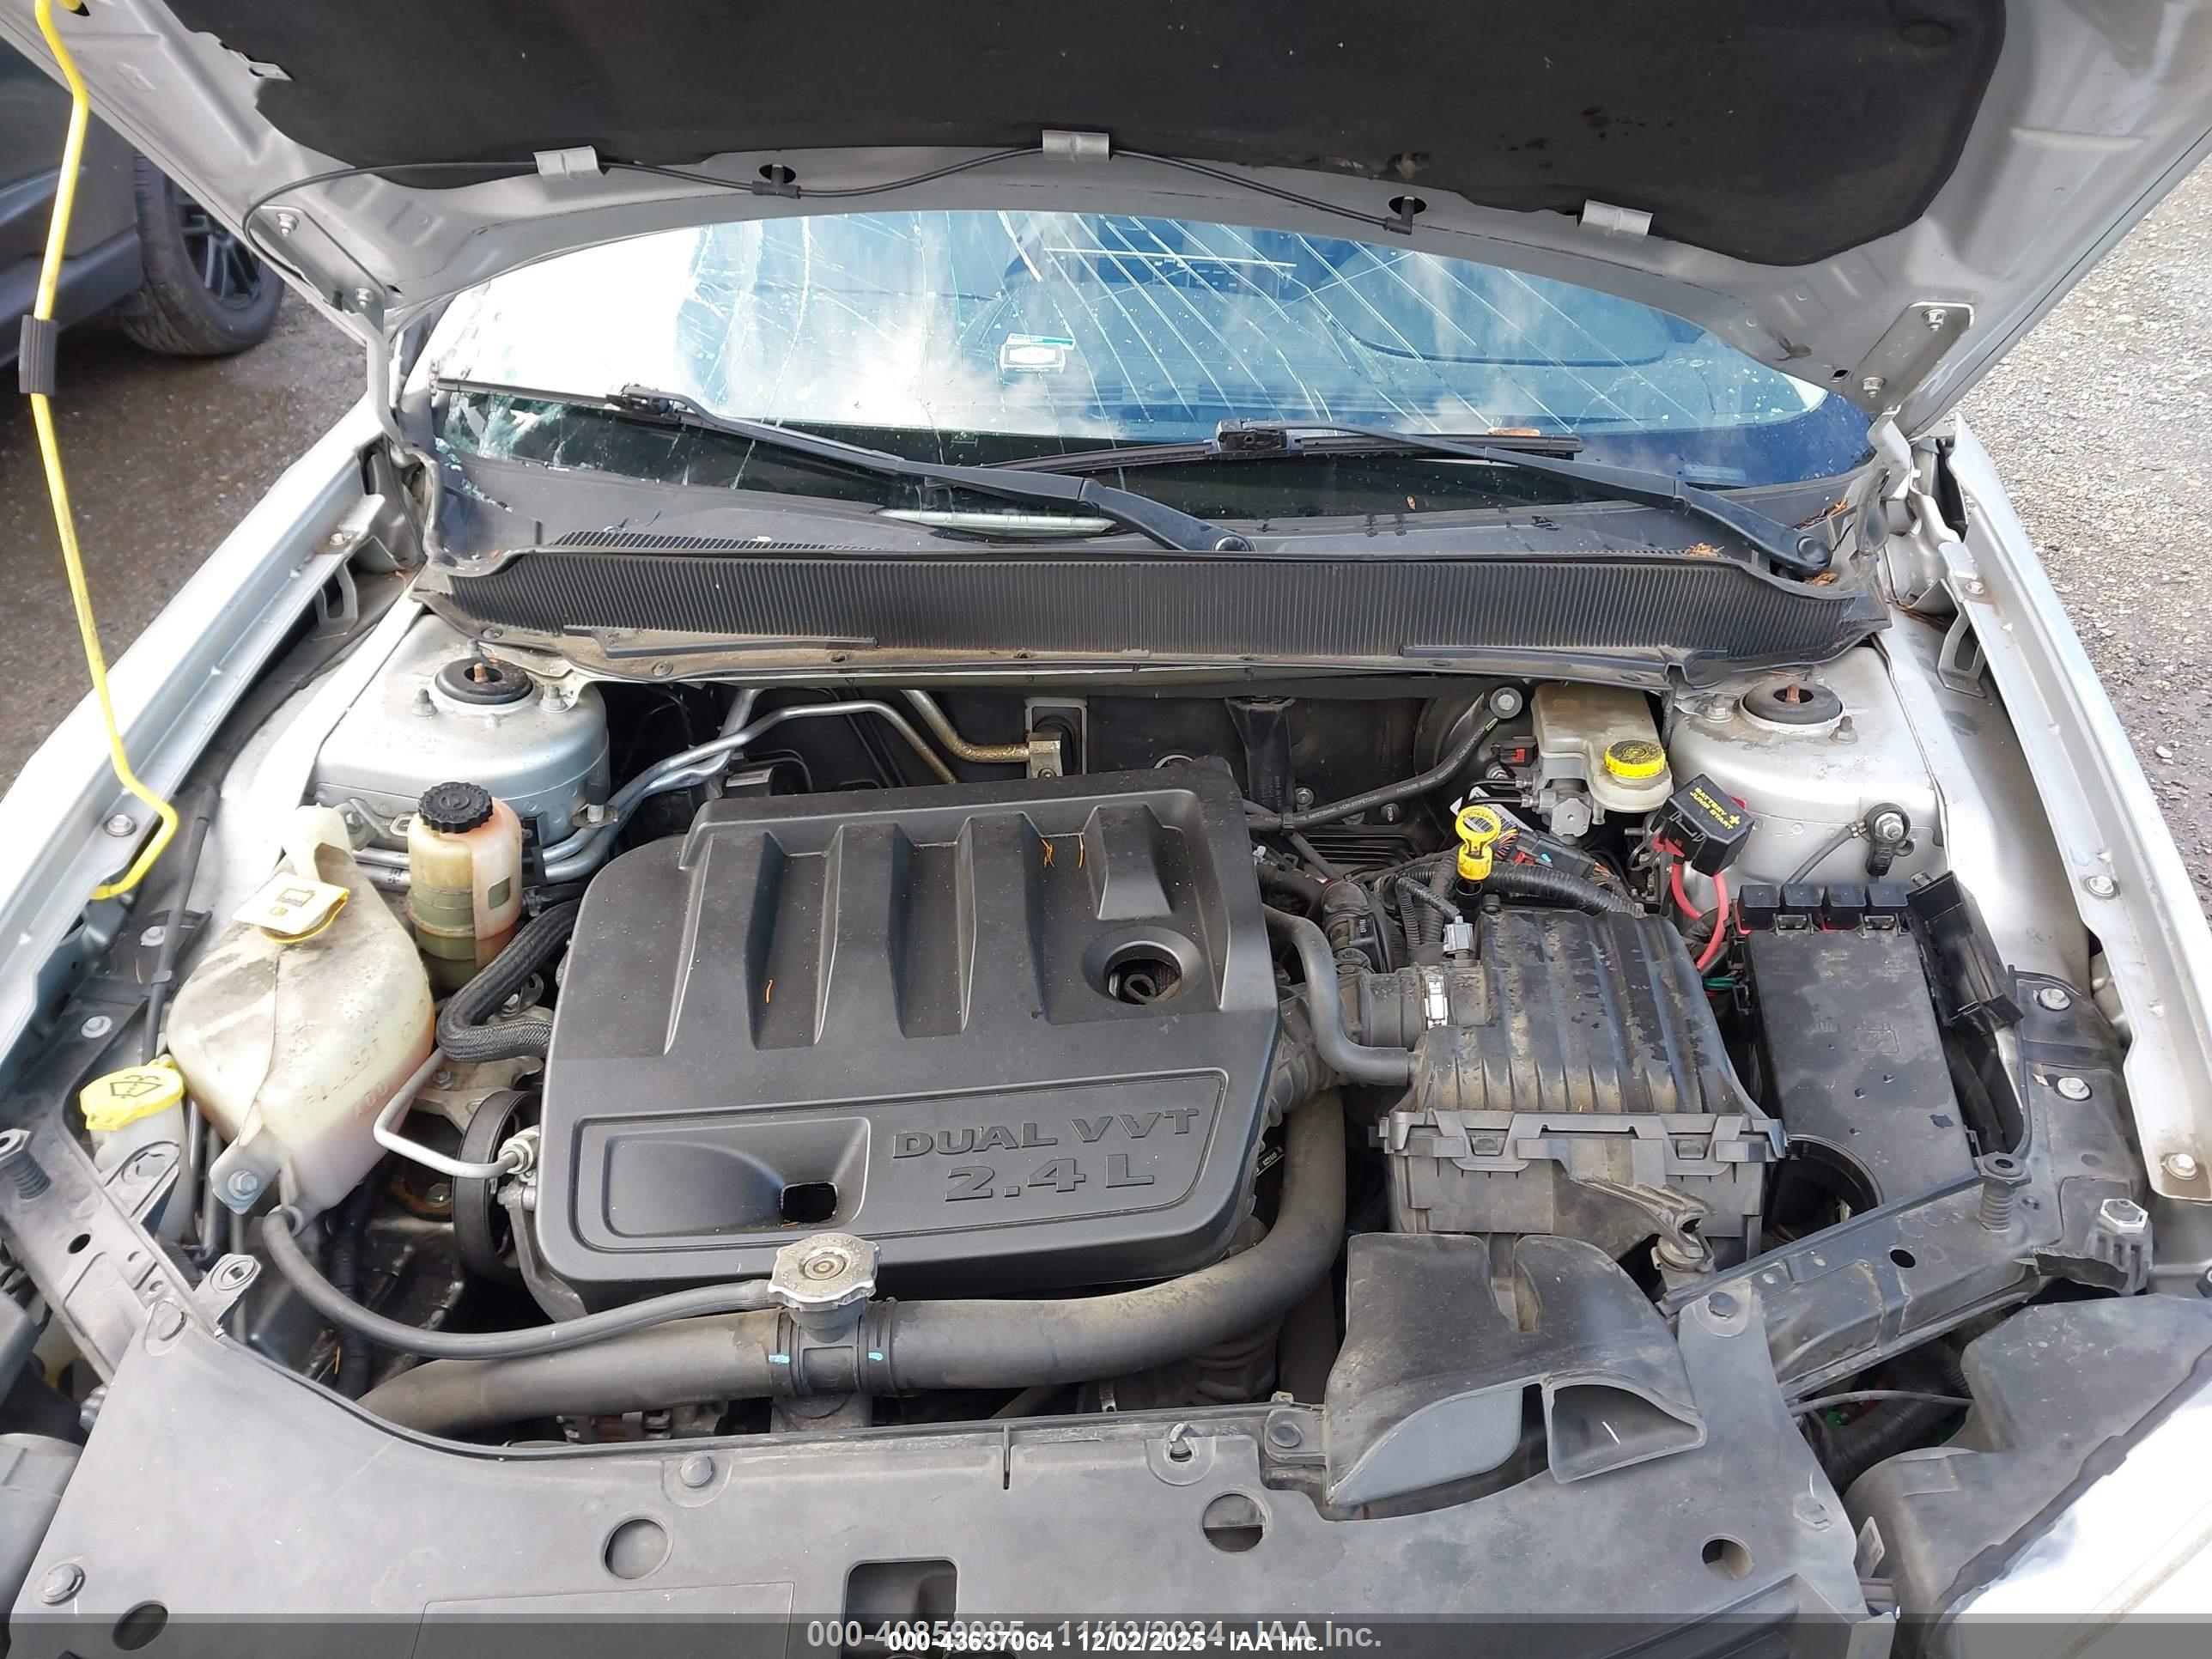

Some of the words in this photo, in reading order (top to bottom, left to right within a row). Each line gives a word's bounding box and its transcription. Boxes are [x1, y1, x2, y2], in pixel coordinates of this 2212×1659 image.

[1689, 791, 1711, 810] JUMP
[1709, 809, 1734, 830] START
[1694, 787, 1728, 816] BATTERY
[893, 1121, 1058, 1158] DUAL
[1070, 1108, 1199, 1143] VVT
